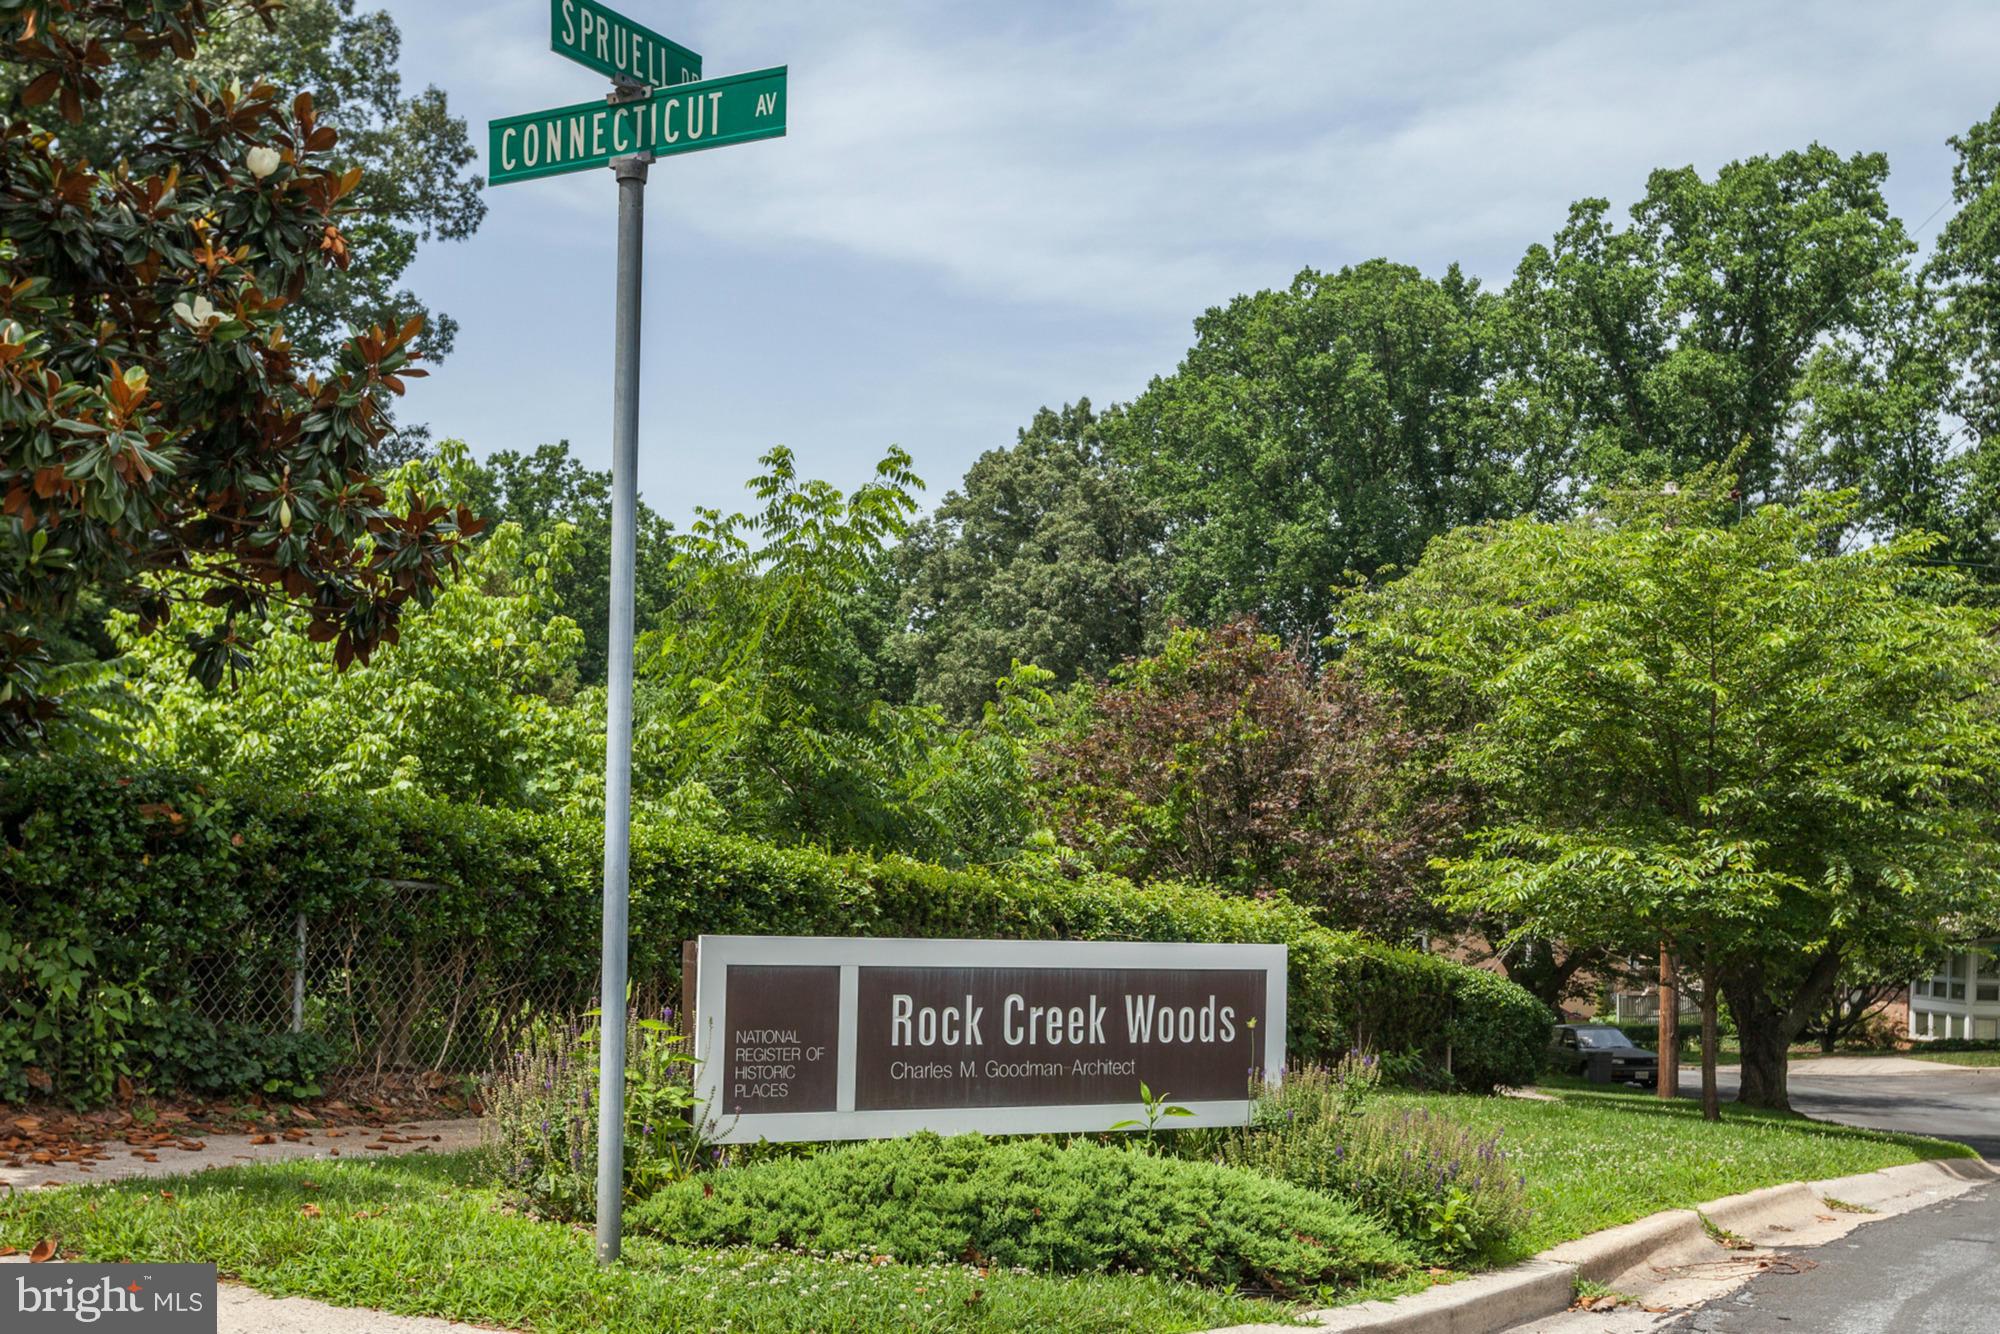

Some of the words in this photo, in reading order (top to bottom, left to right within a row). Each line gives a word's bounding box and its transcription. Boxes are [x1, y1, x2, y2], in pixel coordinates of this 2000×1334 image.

[562, 0, 667, 87] SPRUELL
[501, 92, 723, 171] CONNECTICUT
[755, 92, 777, 117] AV
[891, 994, 984, 1046] Rock
[1004, 993, 1106, 1045] Creek
[1125, 994, 1236, 1044] Woods
[736, 1029, 801, 1044] NATIONAL
[735, 1048, 801, 1062] REGISTER
[806, 1047, 825, 1061] OF
[735, 1065, 796, 1080] HISTORIC
[890, 1061, 953, 1080] Charles
[960, 1060, 978, 1078] M.
[735, 1083, 789, 1098] PLACES
